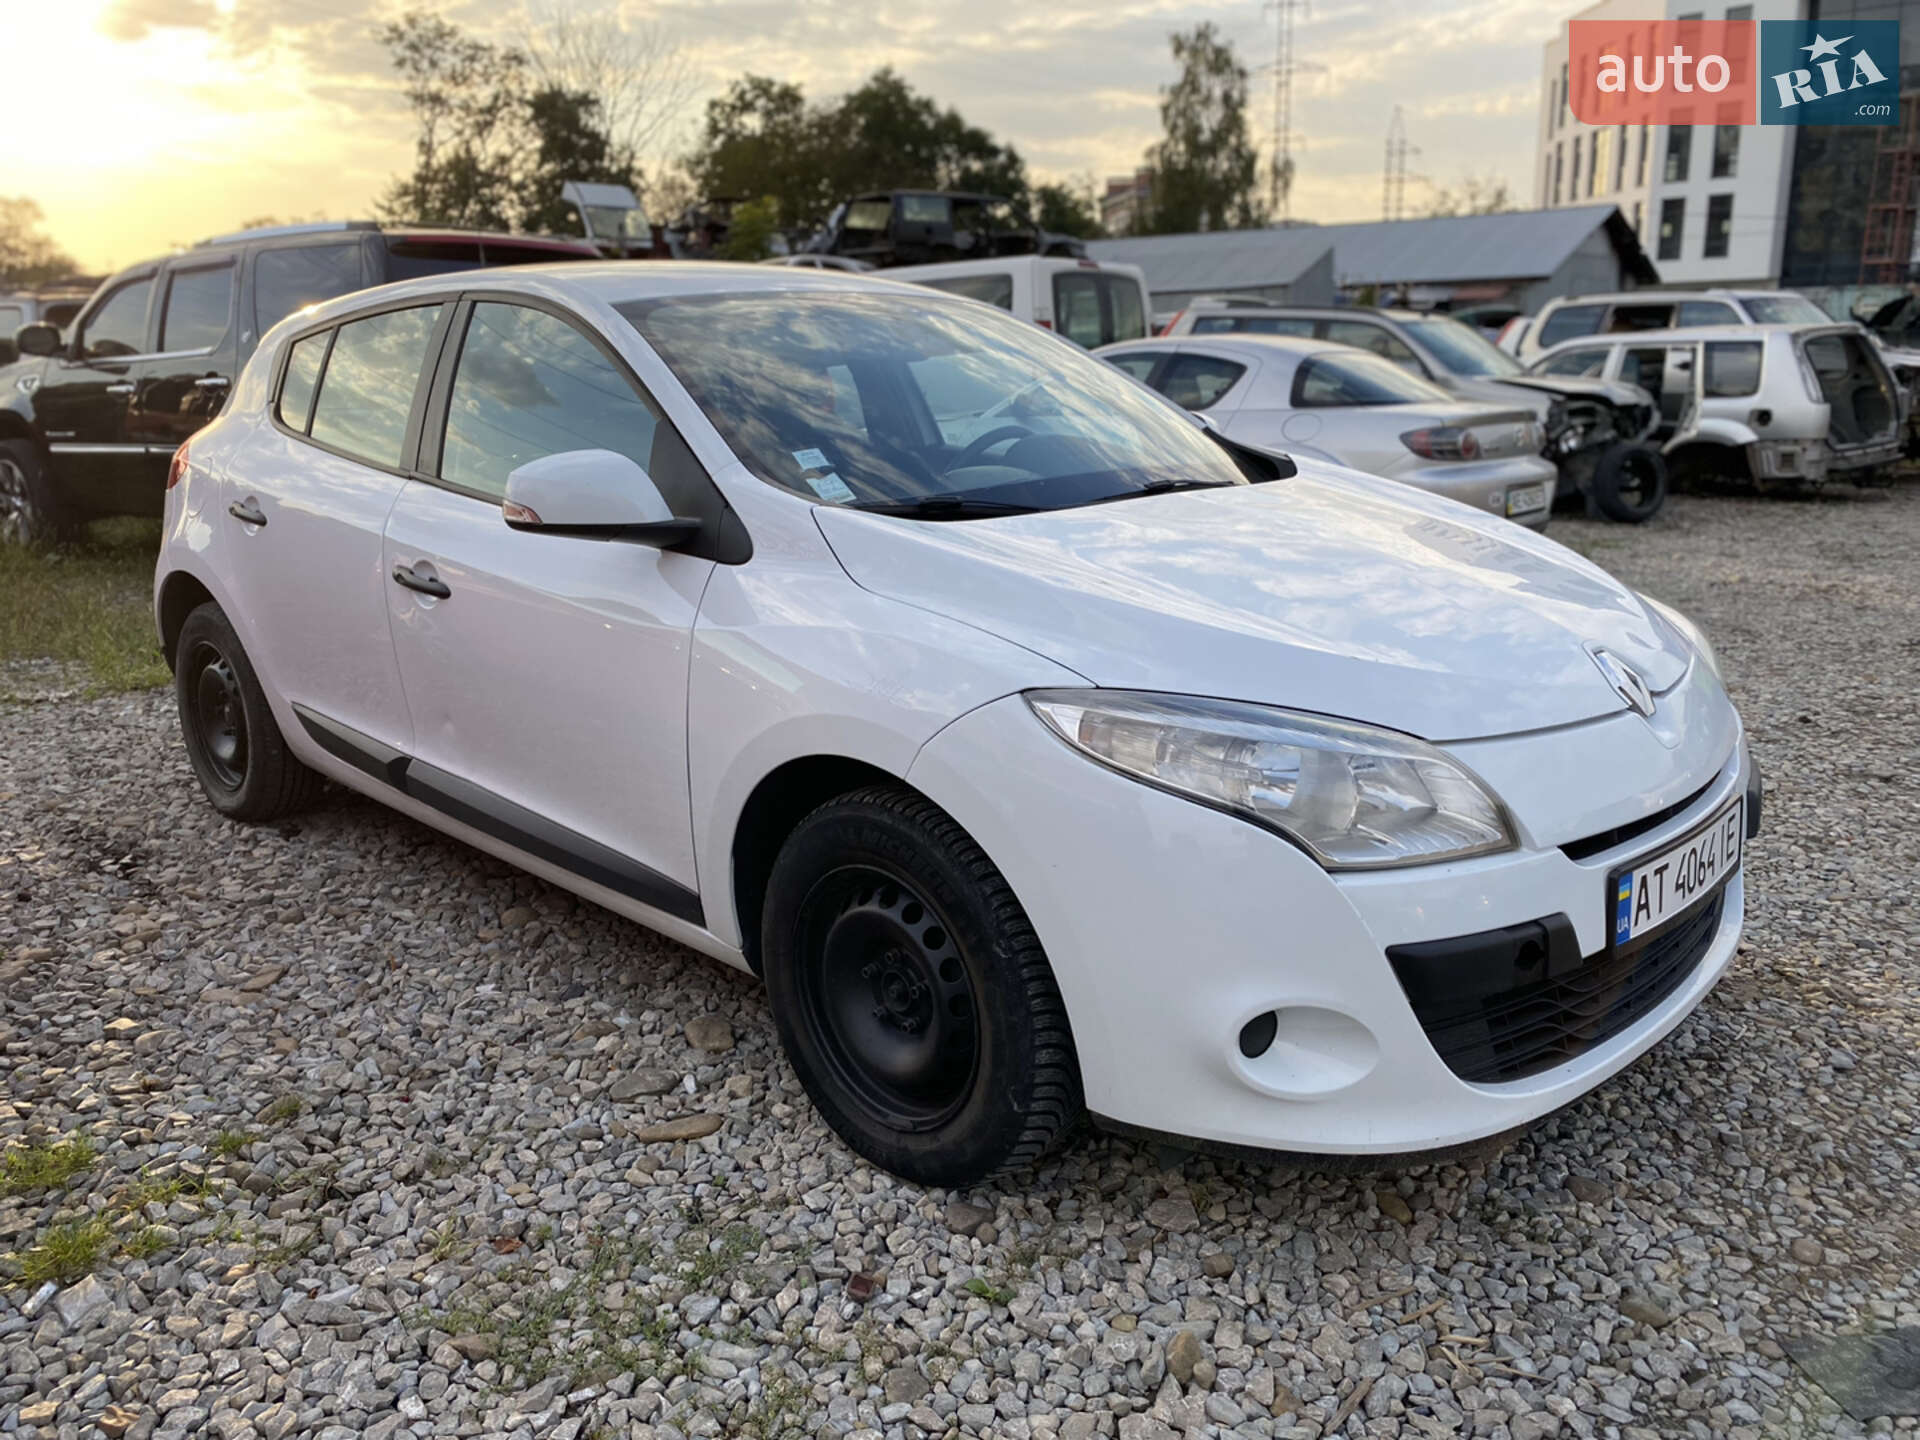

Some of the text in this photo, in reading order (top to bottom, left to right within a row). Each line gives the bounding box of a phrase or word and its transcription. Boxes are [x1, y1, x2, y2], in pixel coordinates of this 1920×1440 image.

[1634, 812, 1736, 926] AT 4064 IE
[1617, 917, 1629, 933] UA
